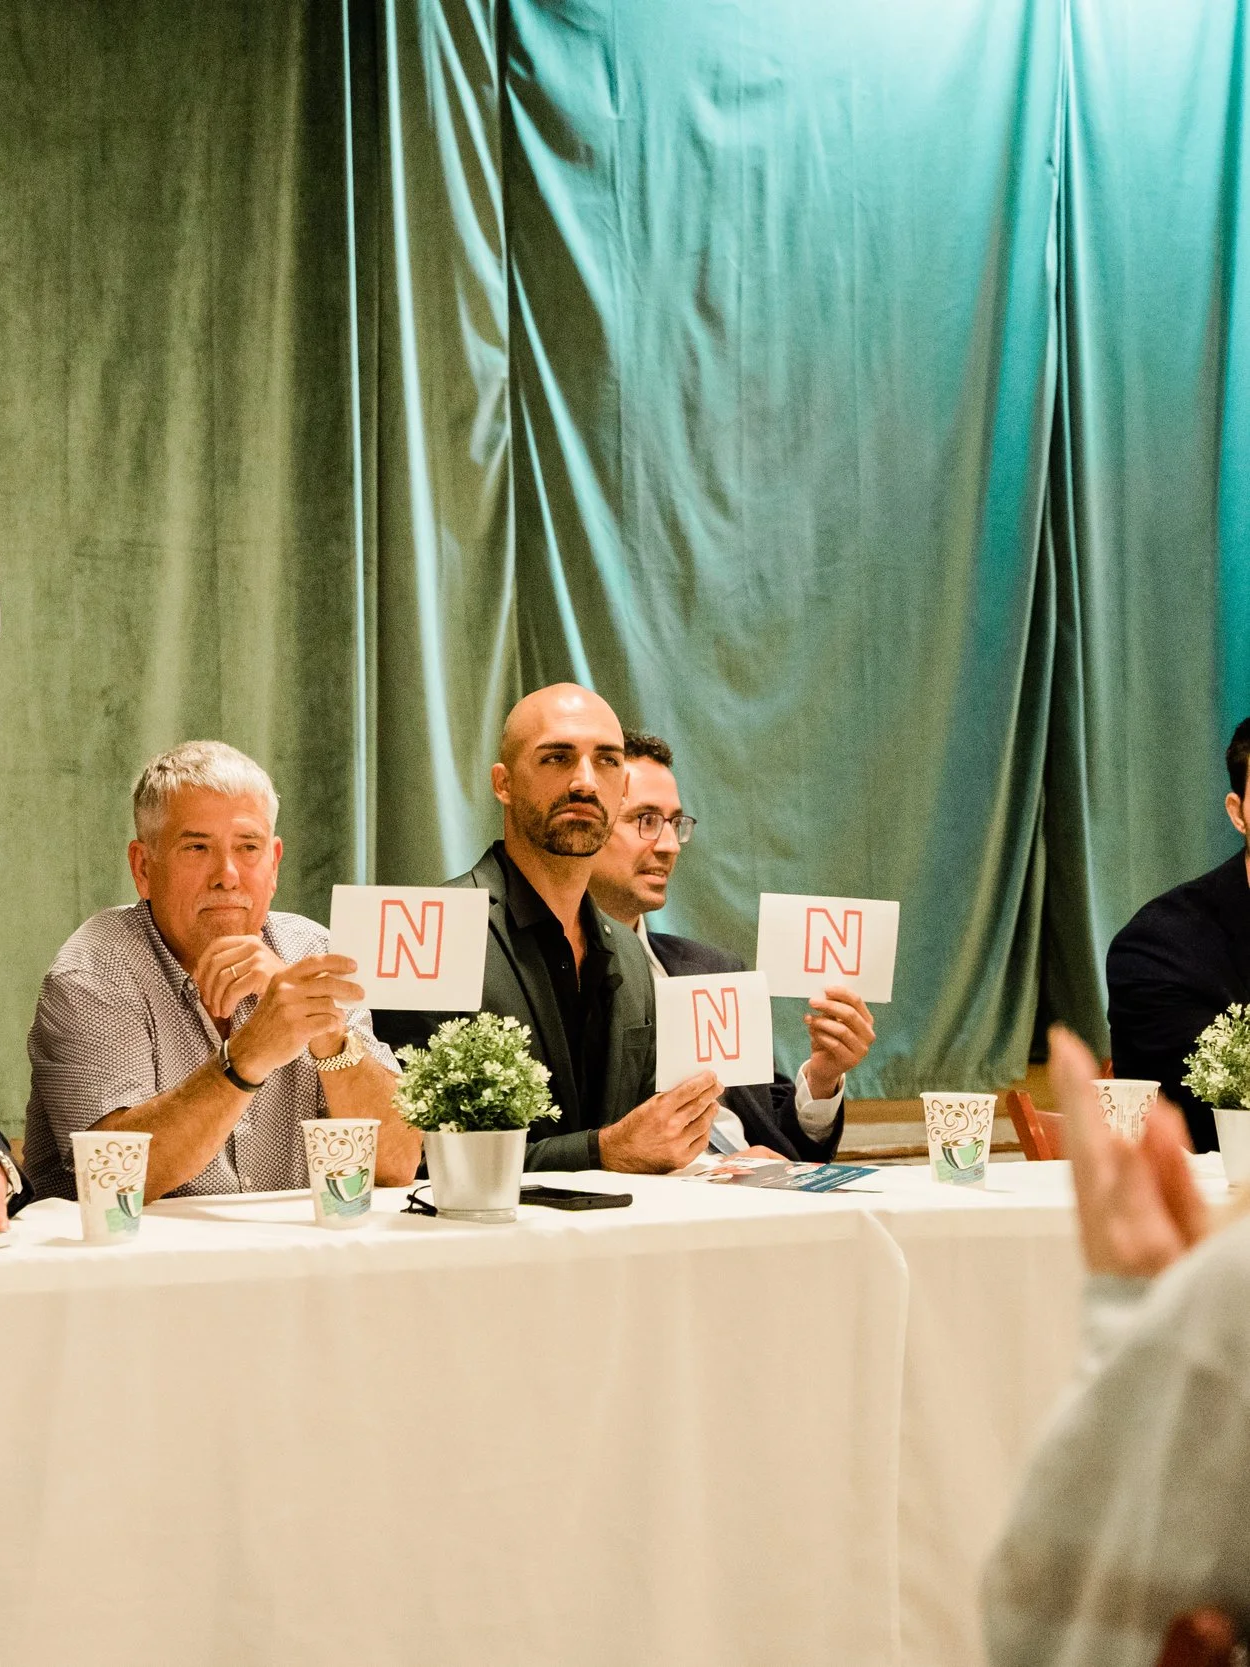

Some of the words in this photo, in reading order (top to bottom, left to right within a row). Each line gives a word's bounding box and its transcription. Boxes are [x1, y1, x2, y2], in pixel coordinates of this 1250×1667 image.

[375, 898, 445, 981] N
[803, 906, 863, 976] N
[691, 987, 741, 1063] N
